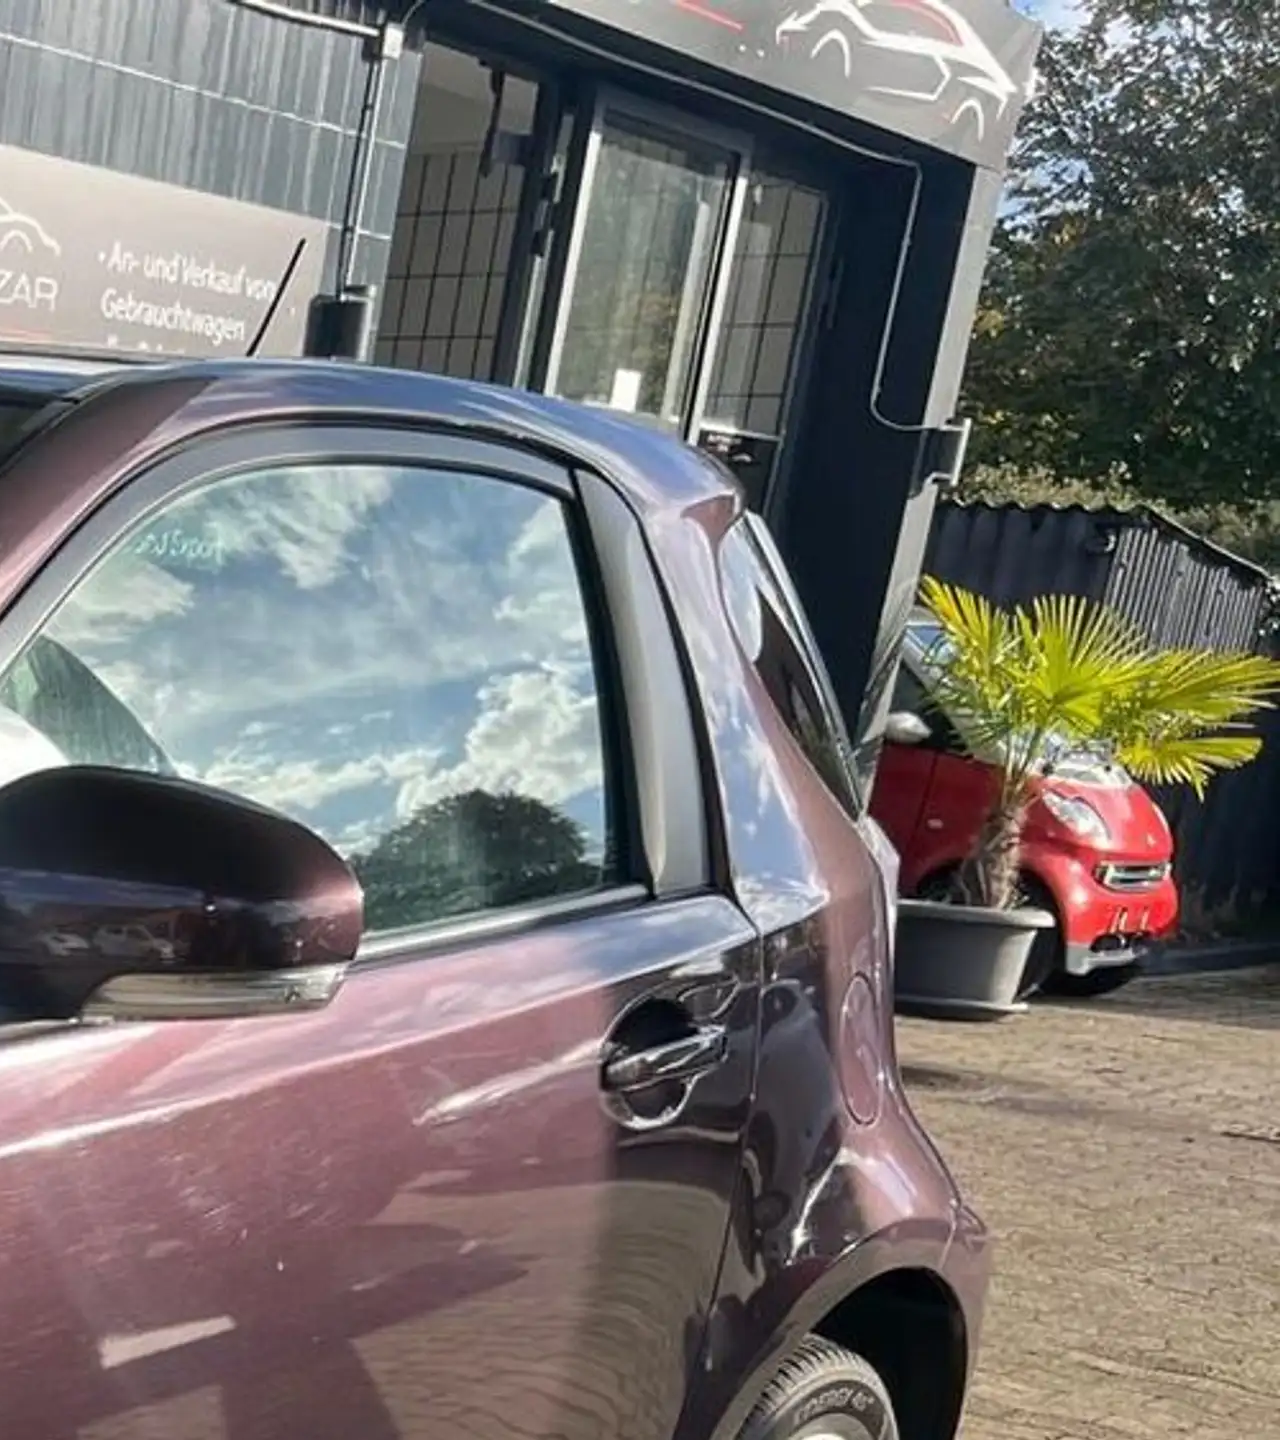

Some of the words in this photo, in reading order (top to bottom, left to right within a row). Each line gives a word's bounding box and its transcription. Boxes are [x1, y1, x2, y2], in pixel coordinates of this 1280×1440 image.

[107, 240, 140, 273] An-
[144, 251, 183, 284] und
[182, 257, 247, 296] Verkauf
[246, 275, 278, 303] von
[100, 287, 246, 347] Gebrauchtwagen
